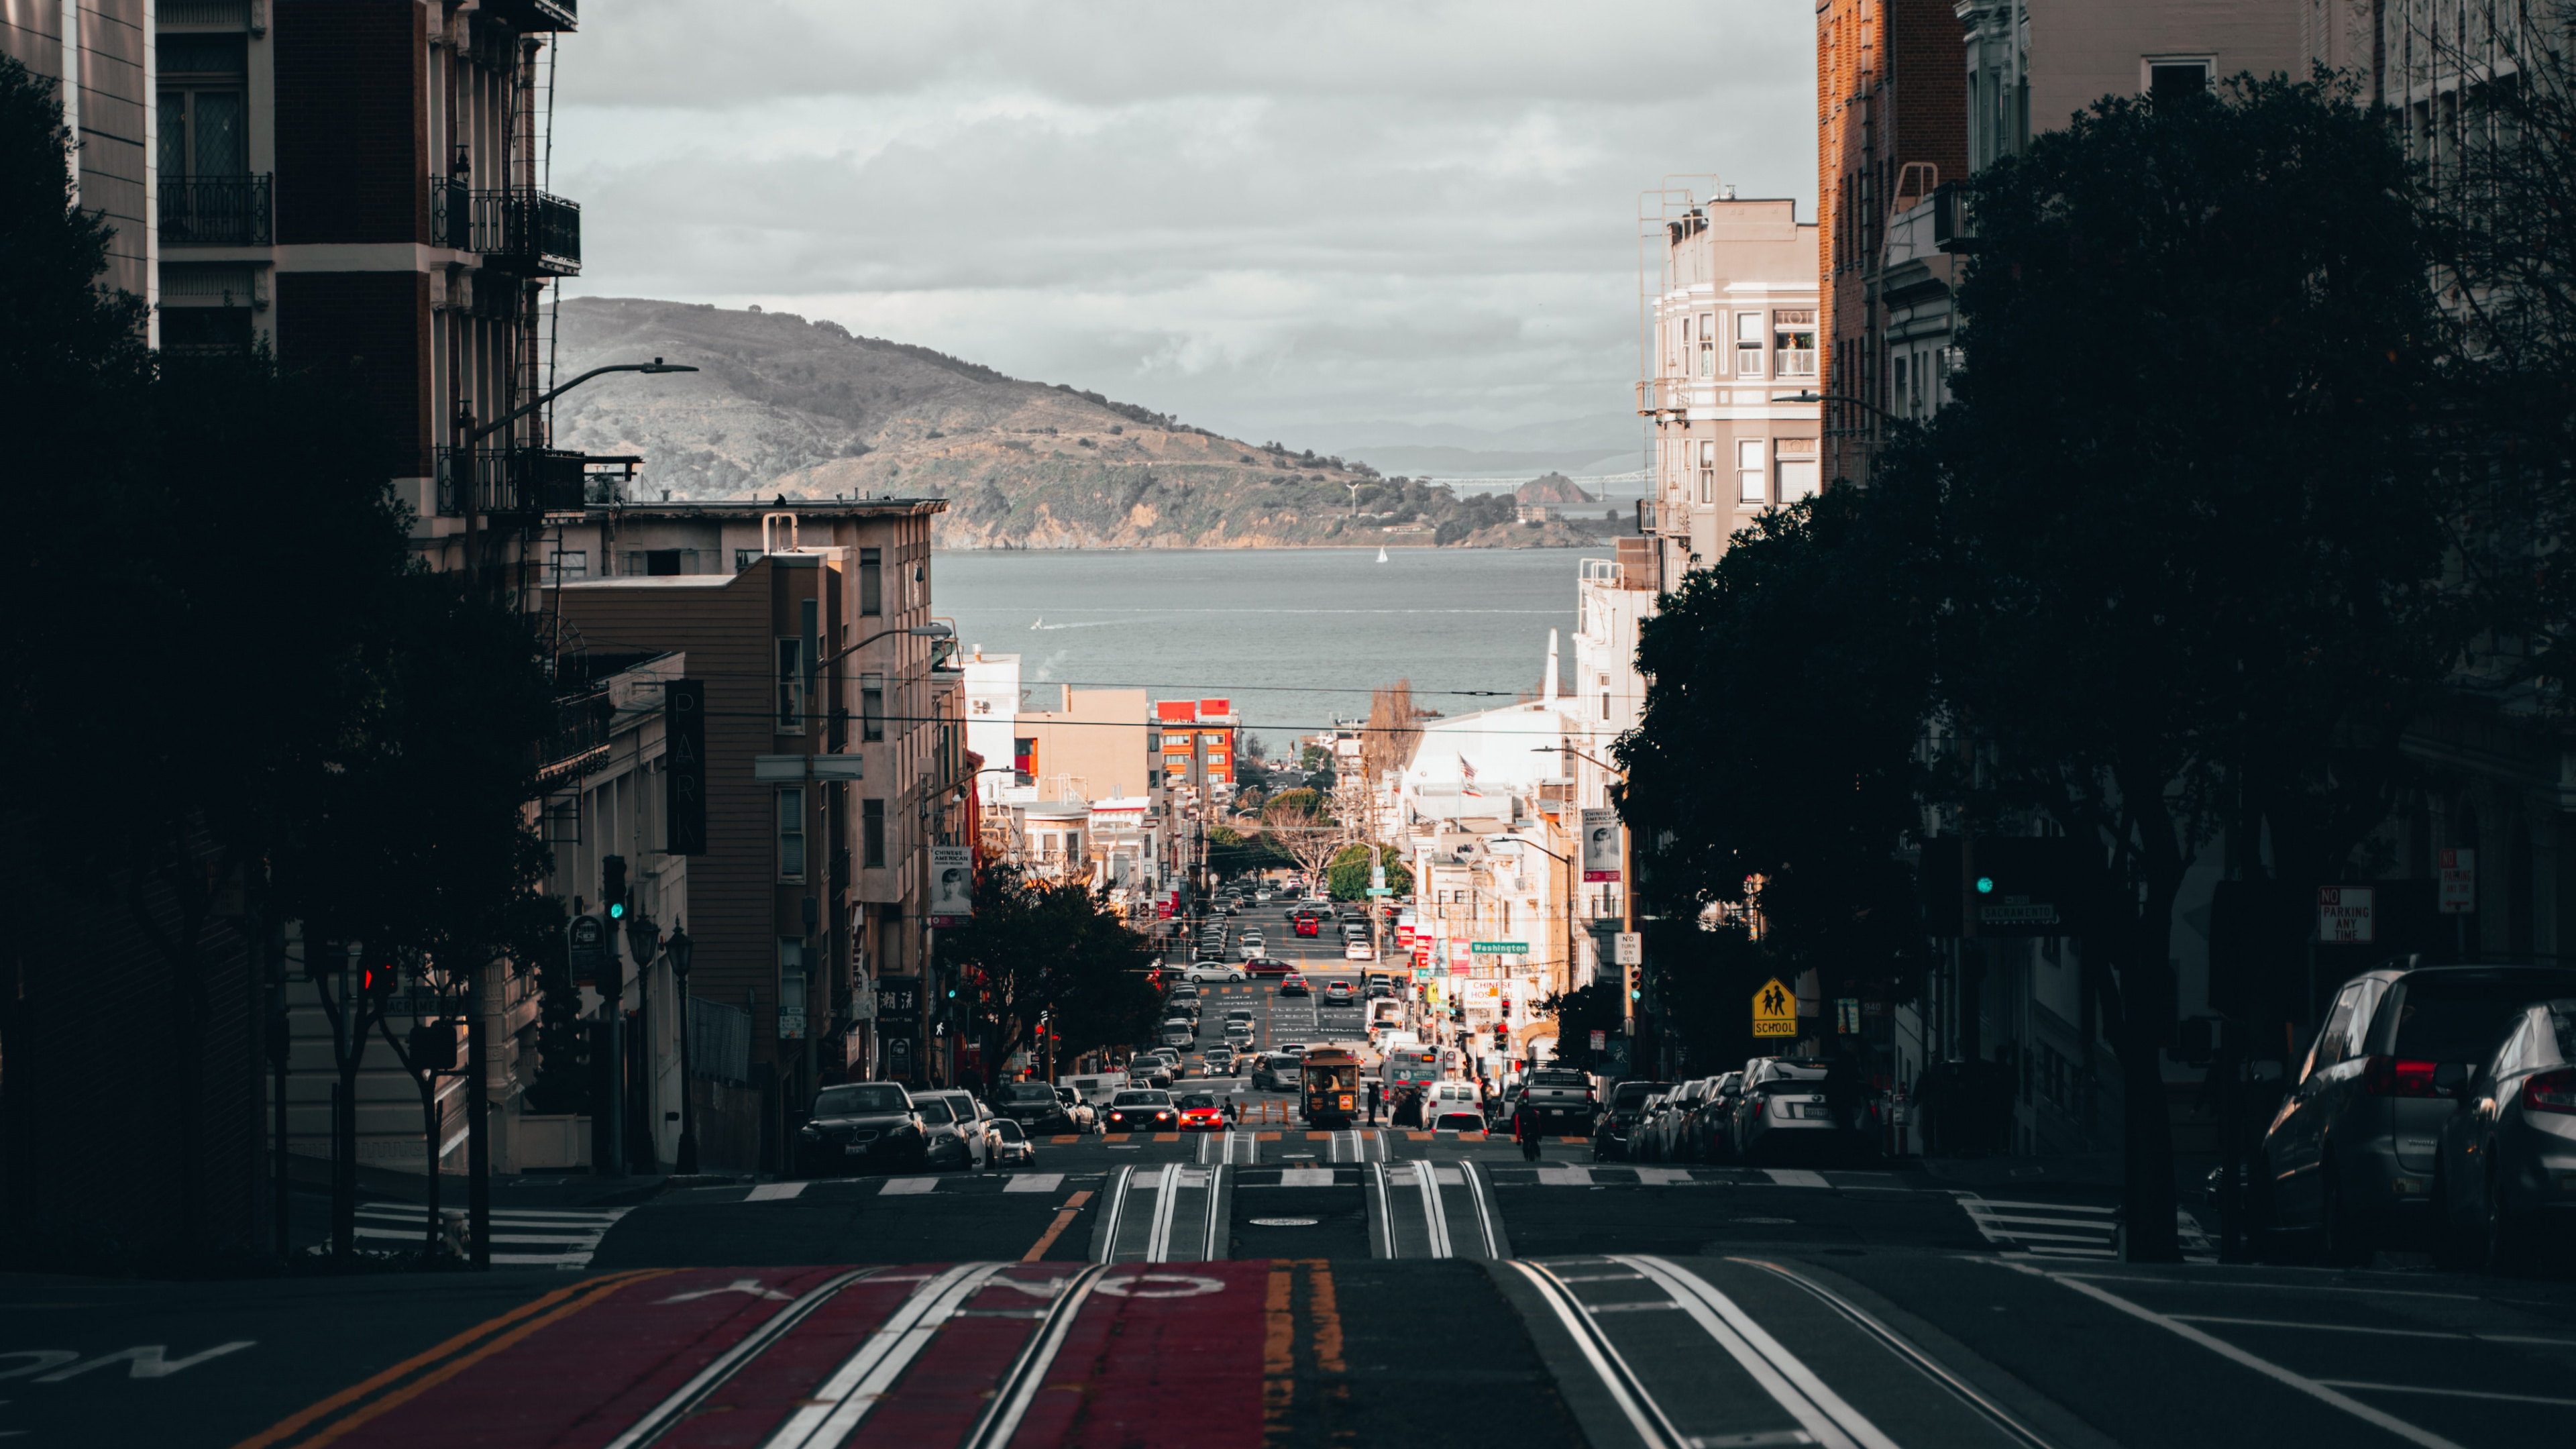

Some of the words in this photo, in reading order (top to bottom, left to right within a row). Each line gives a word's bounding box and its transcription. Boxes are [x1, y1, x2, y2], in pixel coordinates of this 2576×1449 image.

[676, 694, 695, 845] PARK
[2443, 851, 2454, 867] NO
[2447, 884, 2457, 894] ANY
[2459, 884, 2470, 894] TIME
[2322, 889, 2339, 903] NO
[1985, 907, 2050, 918] SACRAMENTO
[2324, 906, 2369, 918] PARKING
[2337, 918, 2357, 929] ANY
[2335, 930, 2358, 941] TIME
[1474, 944, 1527, 953] Washington
[1471, 991, 1515, 999] HOSAL
[1864, 1003, 1881, 1011] 940
[1756, 1022, 1794, 1032] SCHOOL
